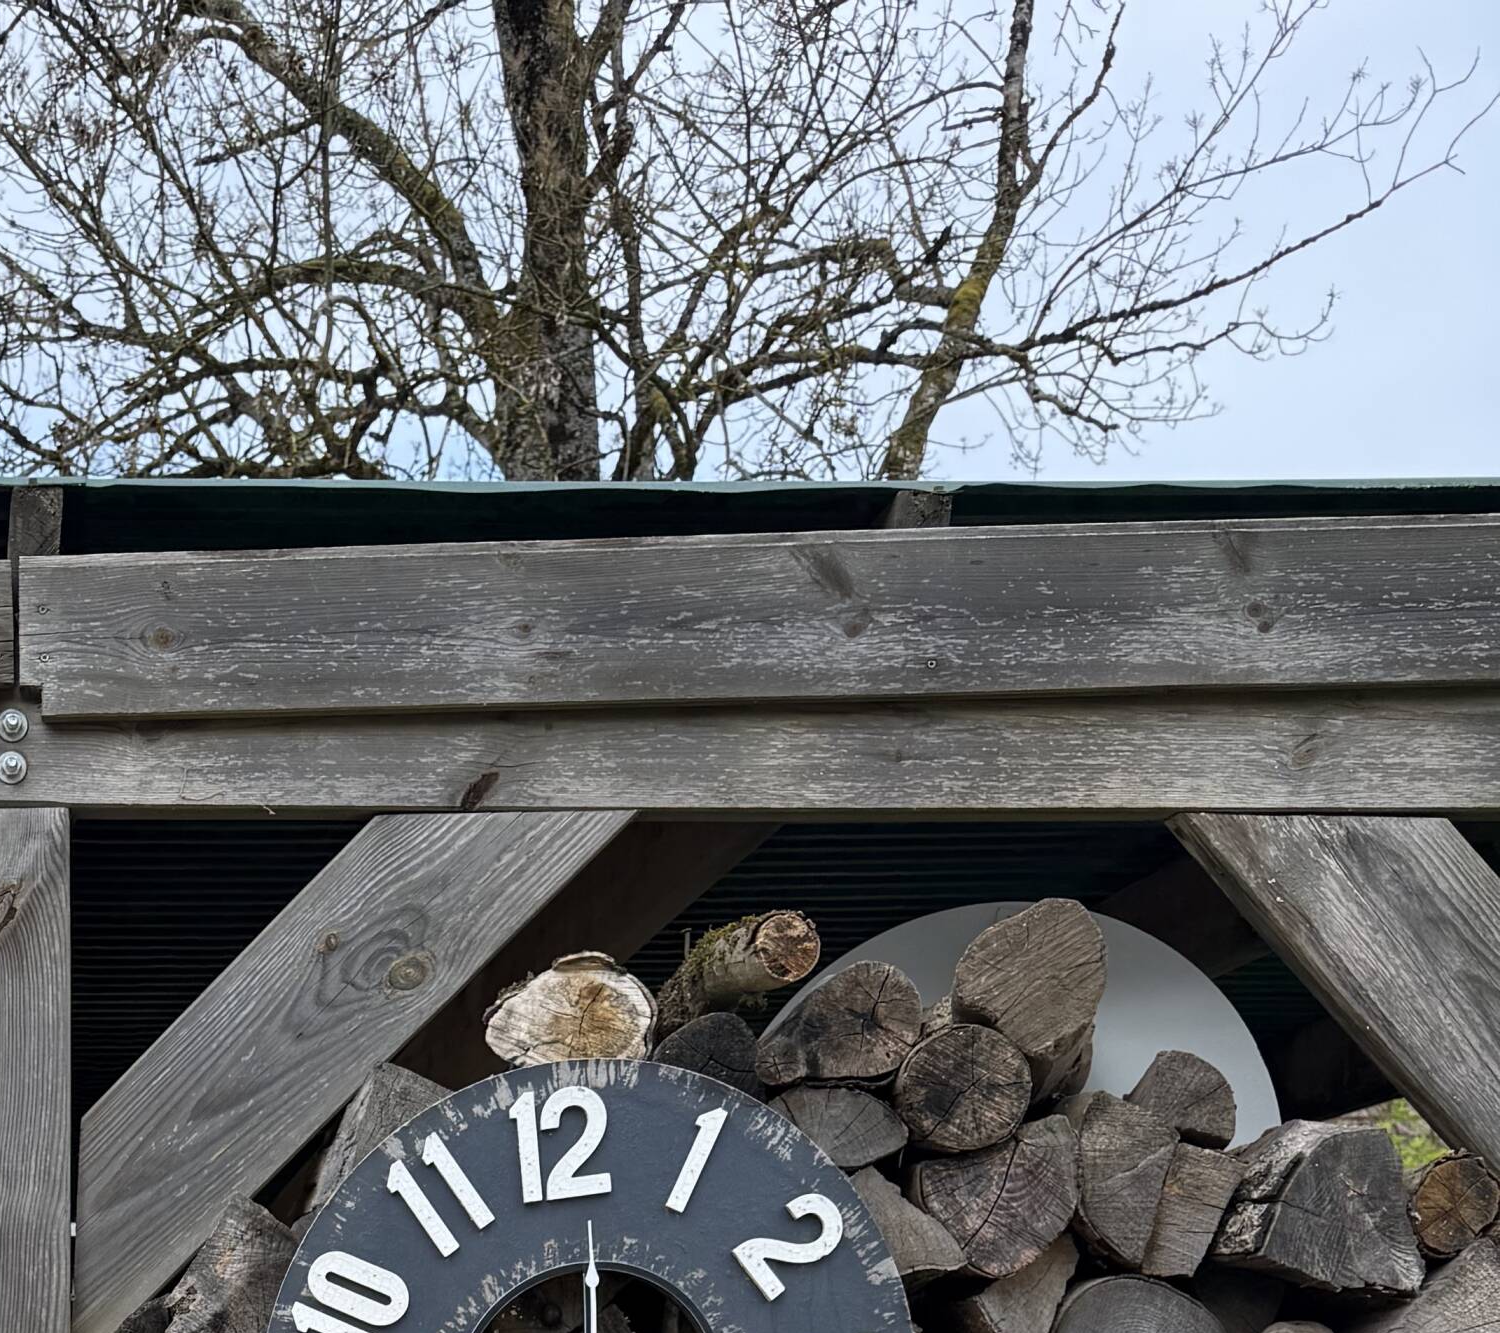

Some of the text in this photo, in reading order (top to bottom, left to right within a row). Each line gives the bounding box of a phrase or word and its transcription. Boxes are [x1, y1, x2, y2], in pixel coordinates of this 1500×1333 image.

[385, 1131, 496, 1259] 11
[508, 1085, 613, 1204] 12
[665, 1107, 730, 1214] 1
[731, 1193, 845, 1302] 2
